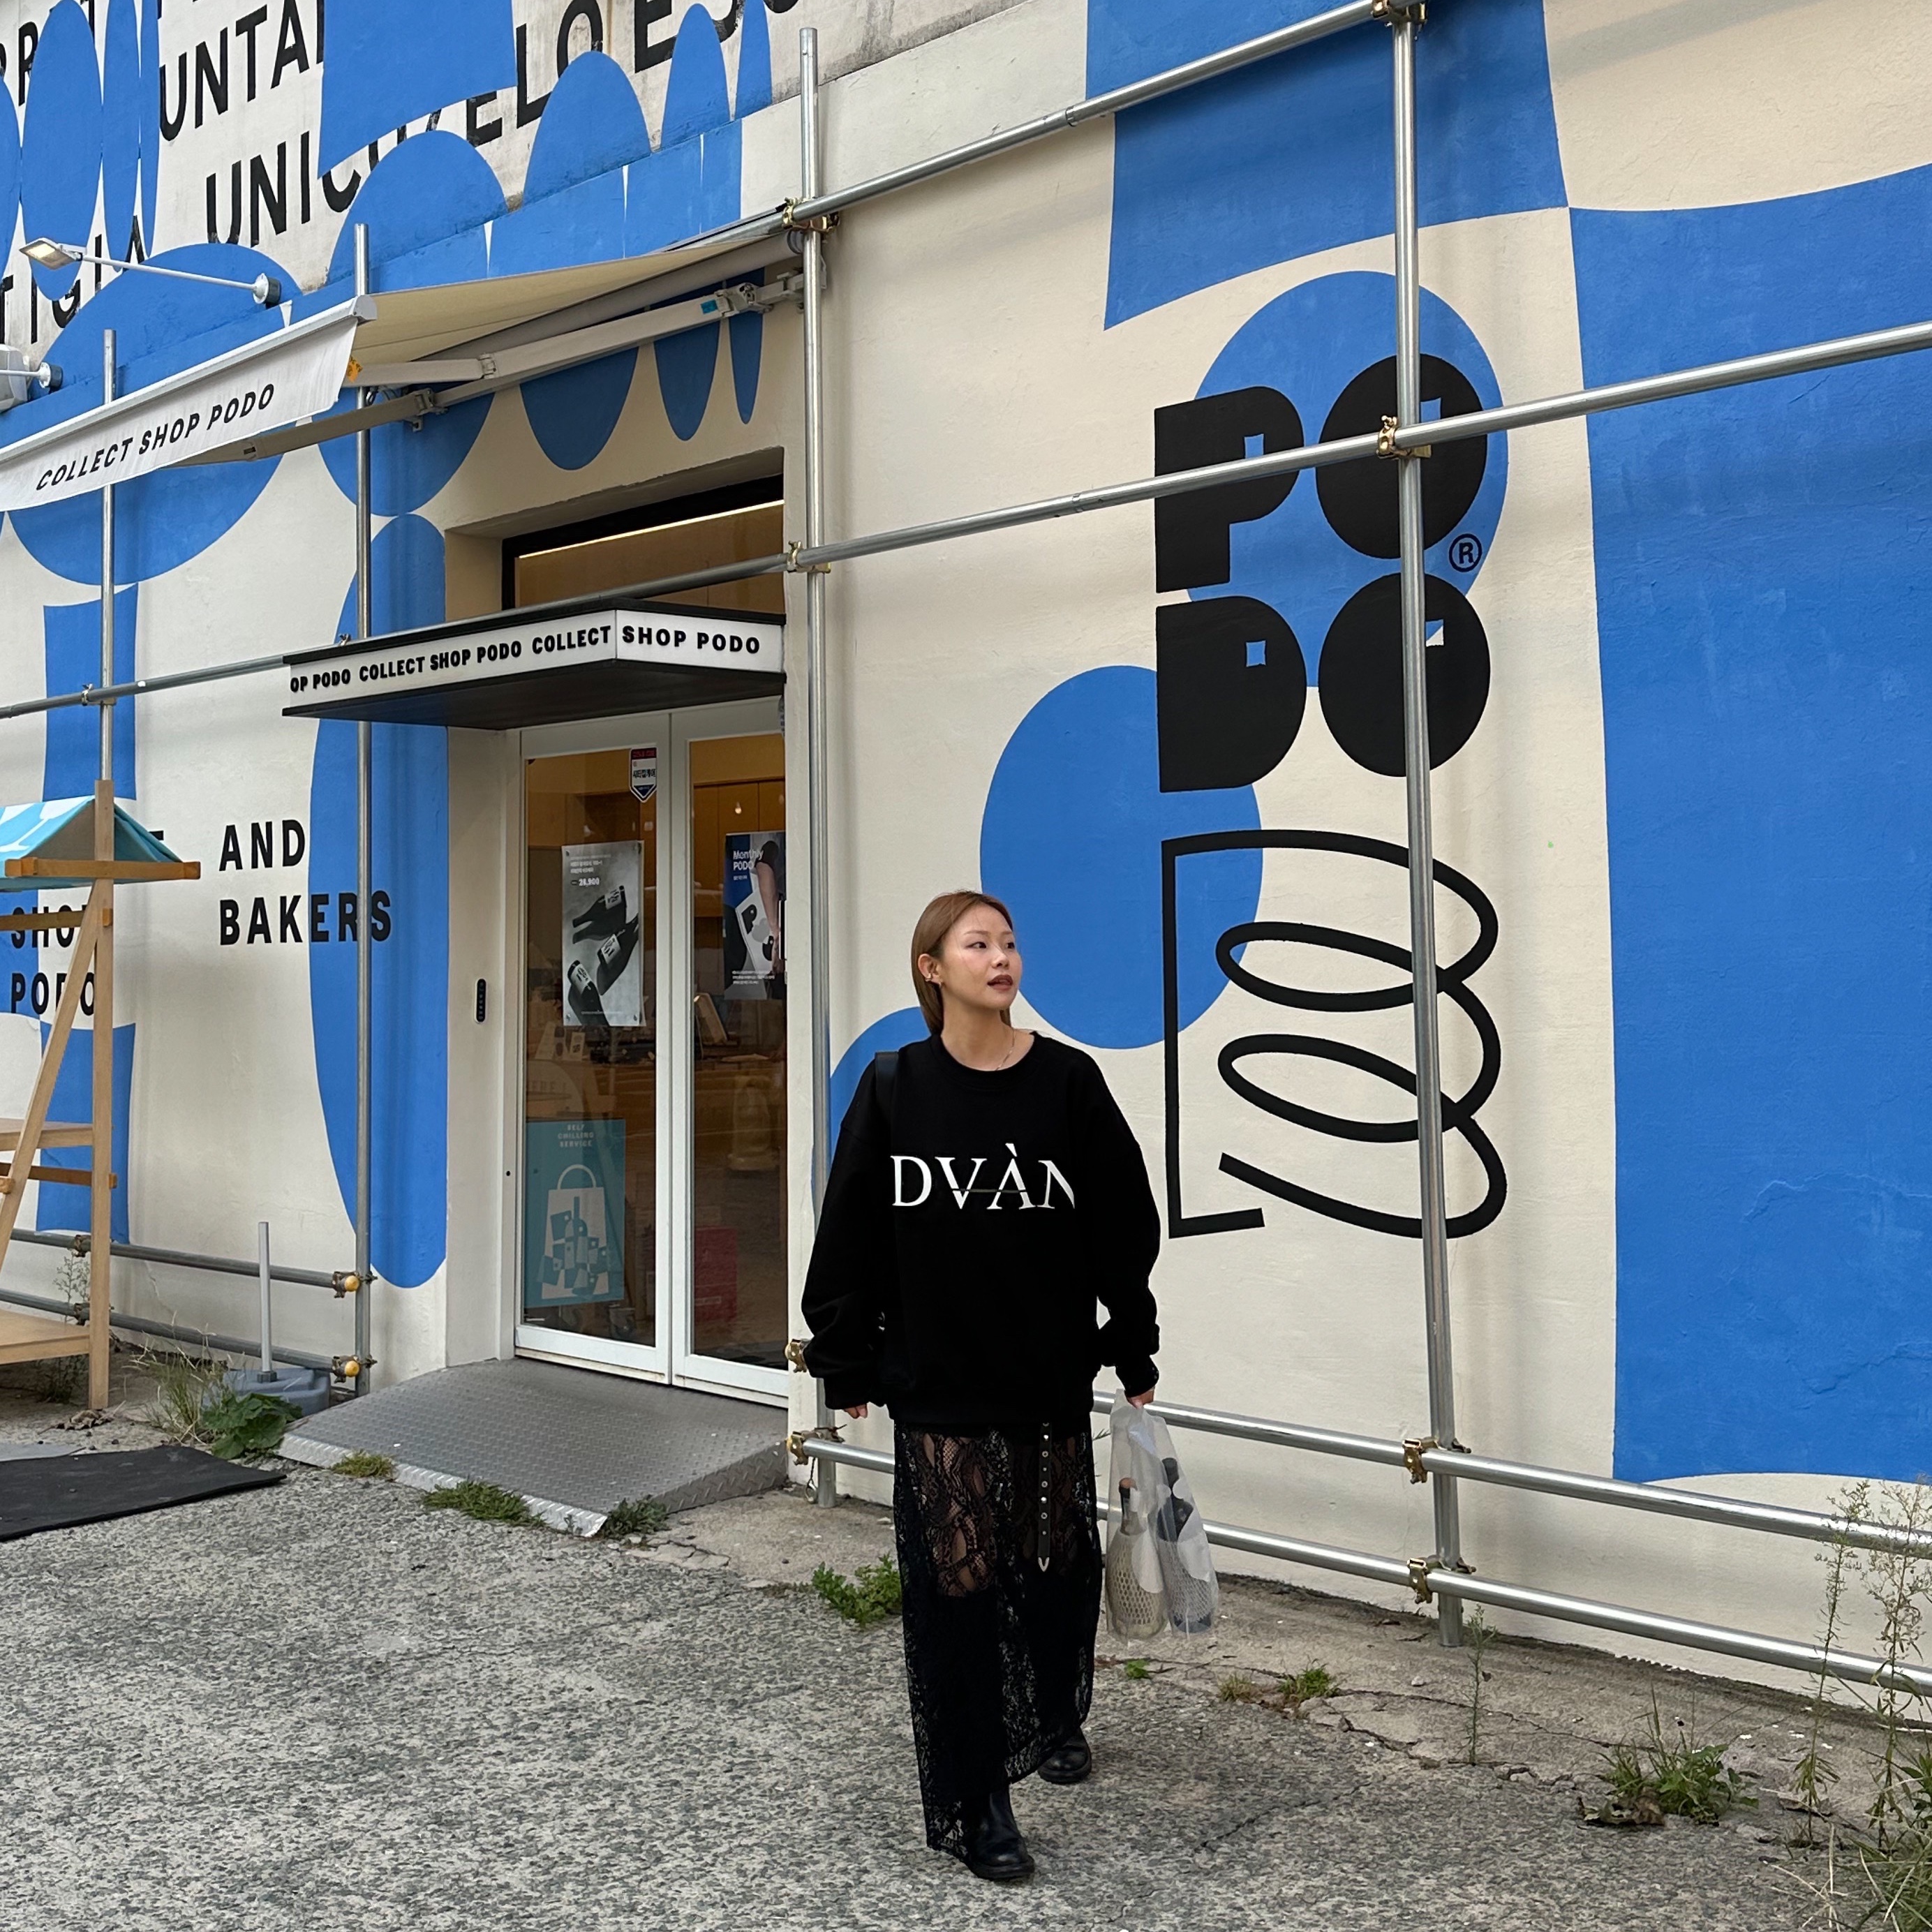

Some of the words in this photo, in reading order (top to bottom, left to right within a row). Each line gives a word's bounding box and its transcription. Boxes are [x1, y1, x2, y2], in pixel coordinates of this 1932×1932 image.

[36, 438, 133, 491] COLLECT
[139, 413, 200, 455] SHOP
[207, 383, 274, 431] PODO
[290, 676, 308, 692] OP
[313, 669, 351, 689] PODO
[359, 656, 426, 682] COLLECT
[430, 648, 471, 671] SHOP
[476, 640, 522, 664] PODO
[532, 625, 611, 654] COLLECT
[622, 625, 687, 647] SHOP
[697, 632, 760, 654] PODO
[219, 819, 306, 872] AND
[733, 849, 764, 861] Monthly
[733, 861, 754, 870] PODO
[11, 905, 88, 949] SHO
[219, 890, 391, 946] BAKERS
